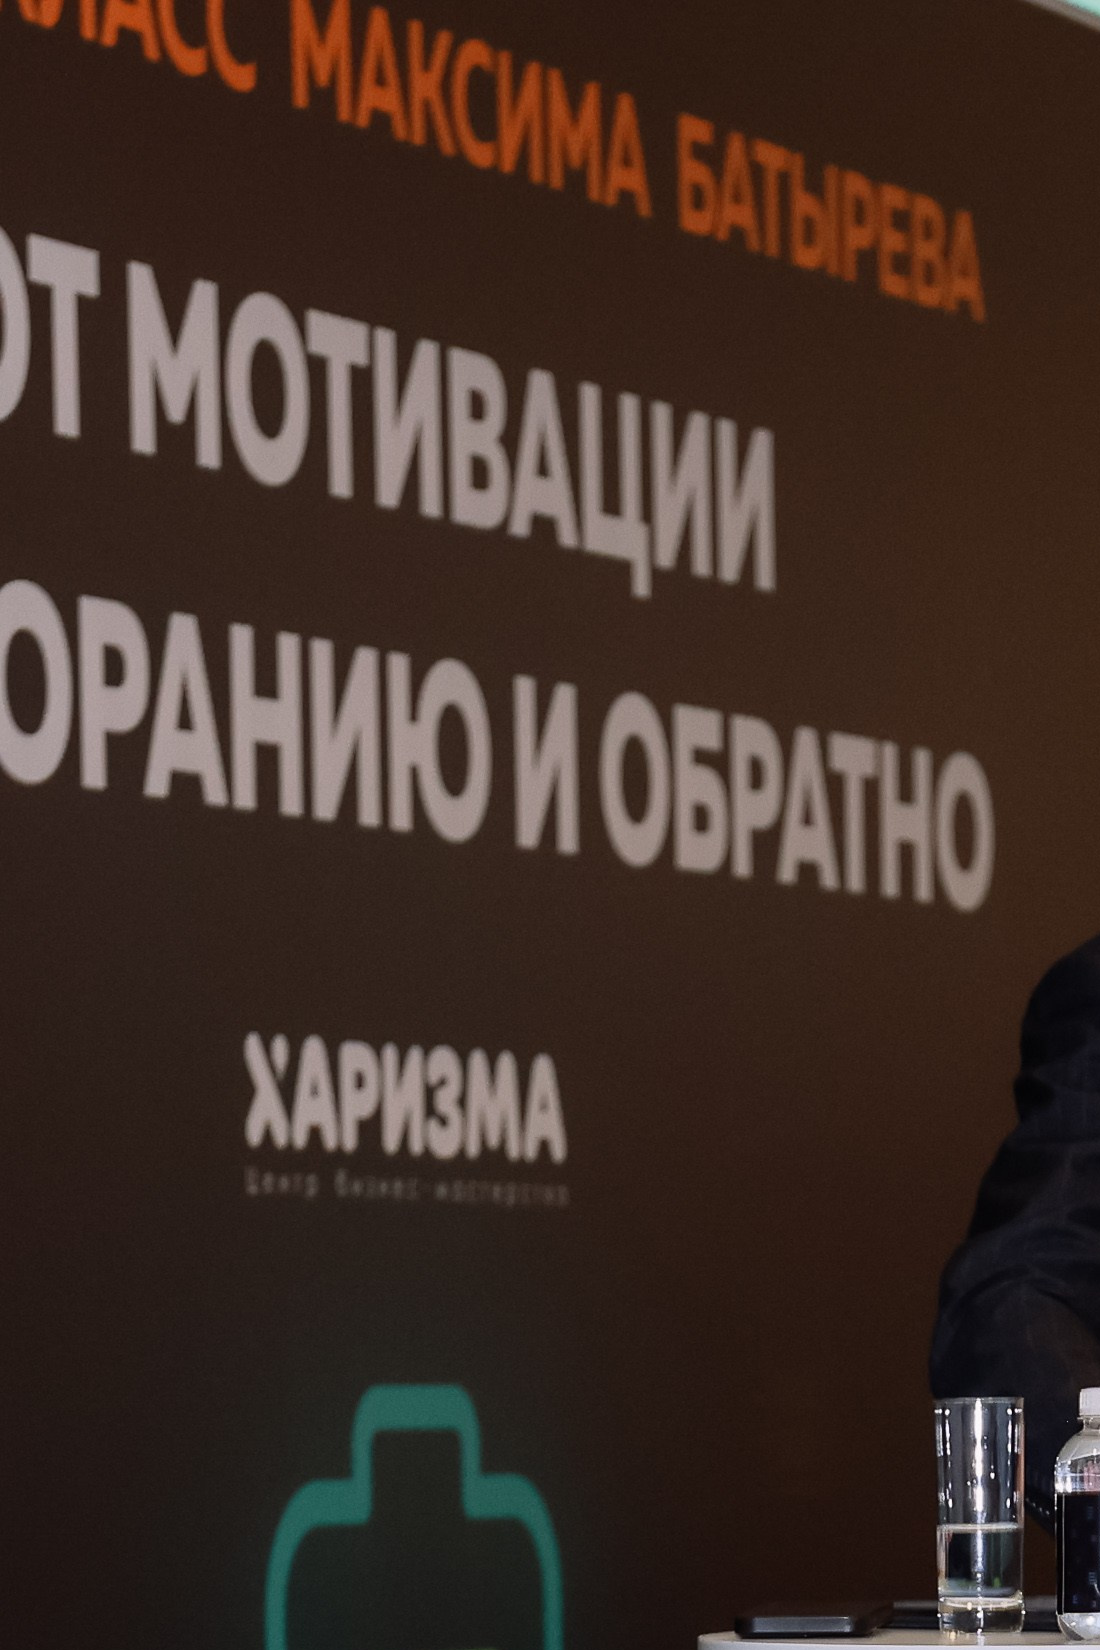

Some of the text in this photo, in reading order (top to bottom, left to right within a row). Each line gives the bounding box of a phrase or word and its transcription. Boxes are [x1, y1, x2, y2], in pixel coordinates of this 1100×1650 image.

[290, 0, 650, 217] МАКСИМА
[677, 113, 985, 322] БАТЫРЕВА
[126, 261, 776, 598] МОТИВАЦИИ
[513, 675, 579, 855] И
[599, 691, 994, 912] ОБРАТНО
[244, 1032, 567, 1164] ХАРИЗМА
